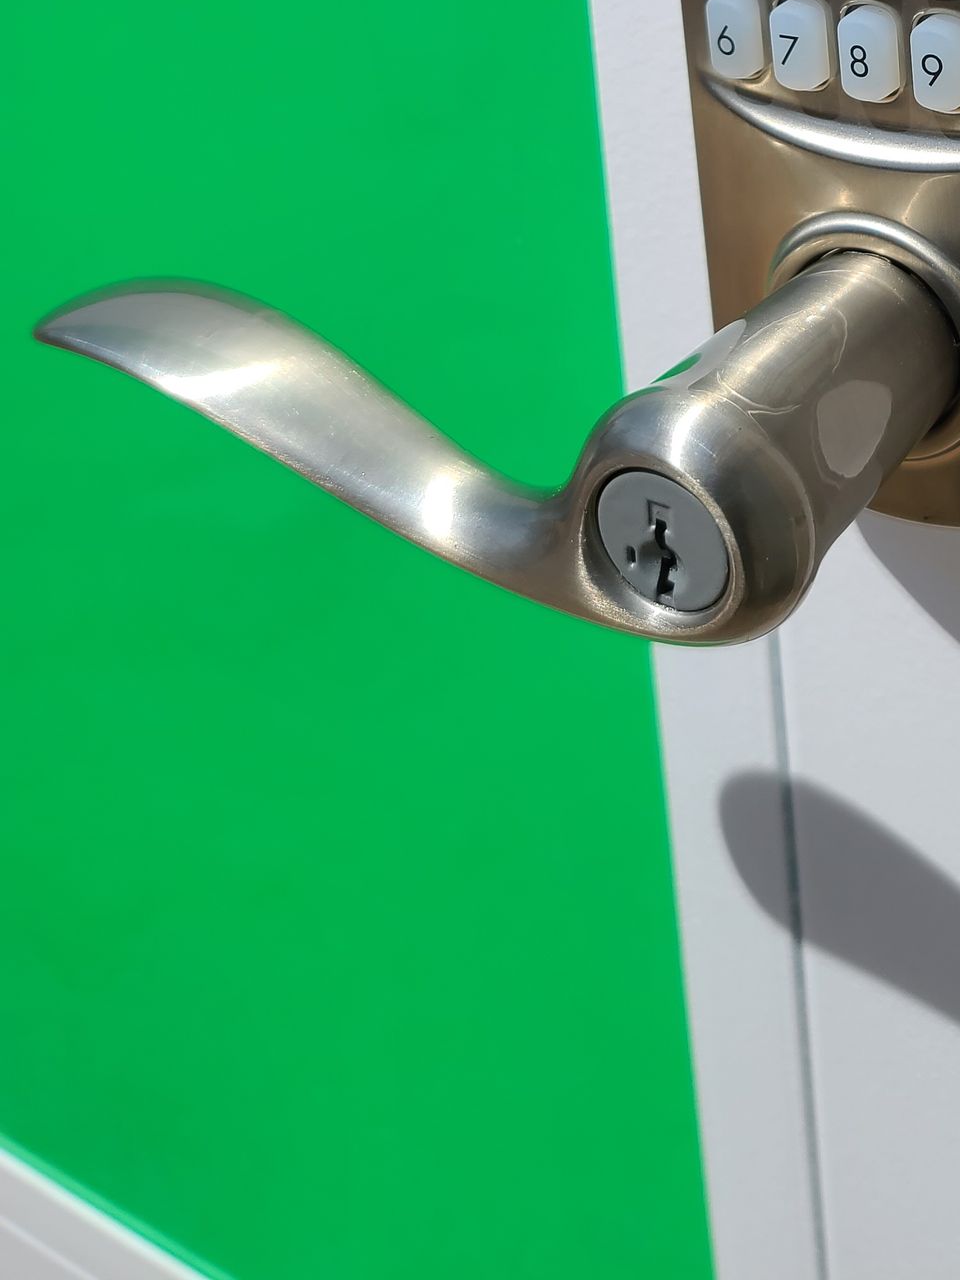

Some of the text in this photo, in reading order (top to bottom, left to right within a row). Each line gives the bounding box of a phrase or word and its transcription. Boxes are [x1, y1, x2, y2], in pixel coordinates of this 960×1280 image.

[718, 26, 735, 55] 6
[779, 35, 798, 65] 7
[851, 45, 868, 77] 8
[922, 54, 943, 86] 9
